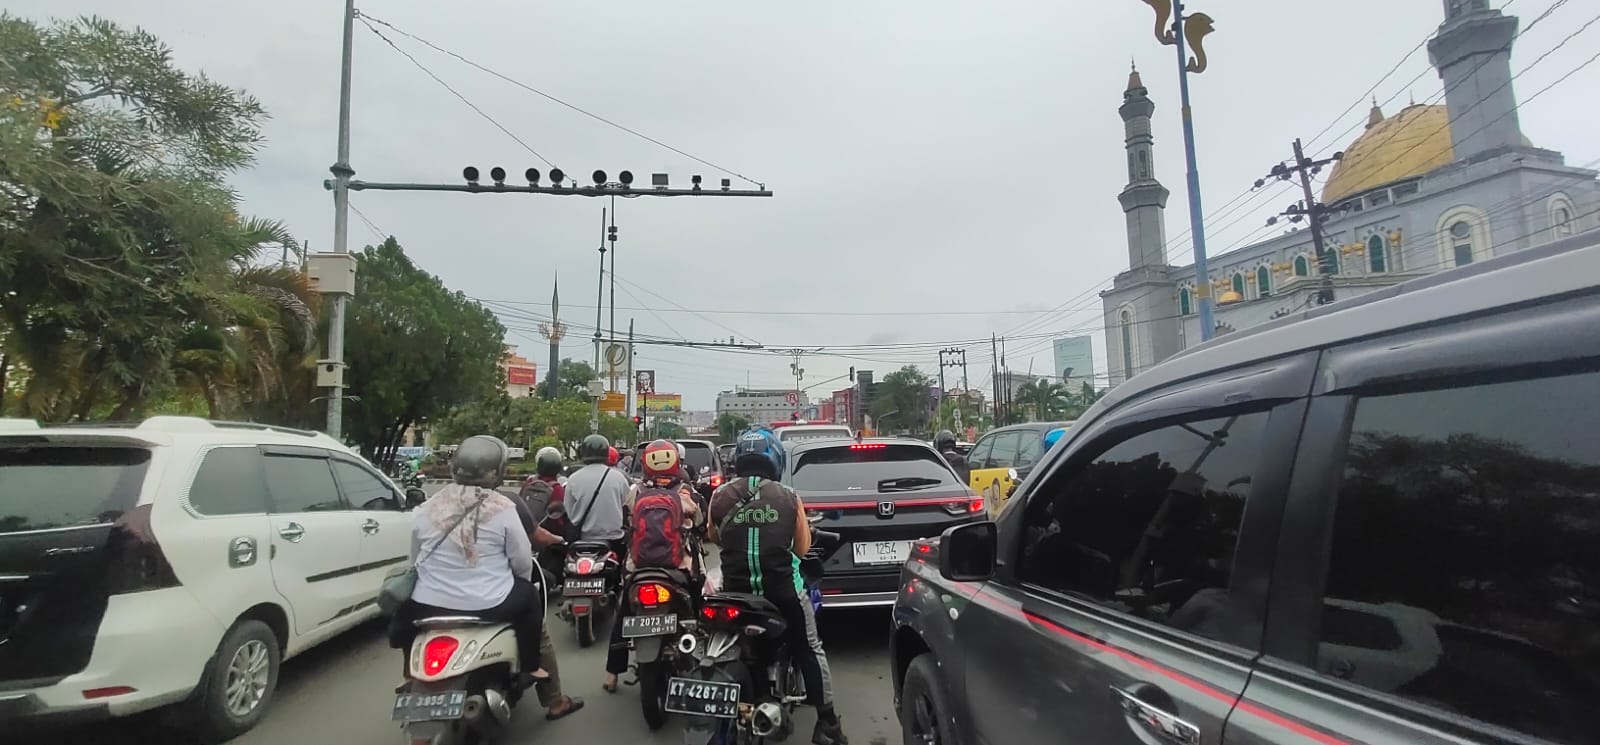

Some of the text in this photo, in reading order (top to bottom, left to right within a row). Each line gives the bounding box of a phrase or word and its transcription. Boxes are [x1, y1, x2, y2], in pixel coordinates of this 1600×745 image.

[733, 504, 779, 524] Grab
[855, 543, 867, 556] KT
[876, 542, 897, 555] 1254
[624, 617, 636, 627] KT
[640, 617, 660, 627] 2073
[670, 682, 685, 696] KT
[688, 685, 718, 700] 4267
